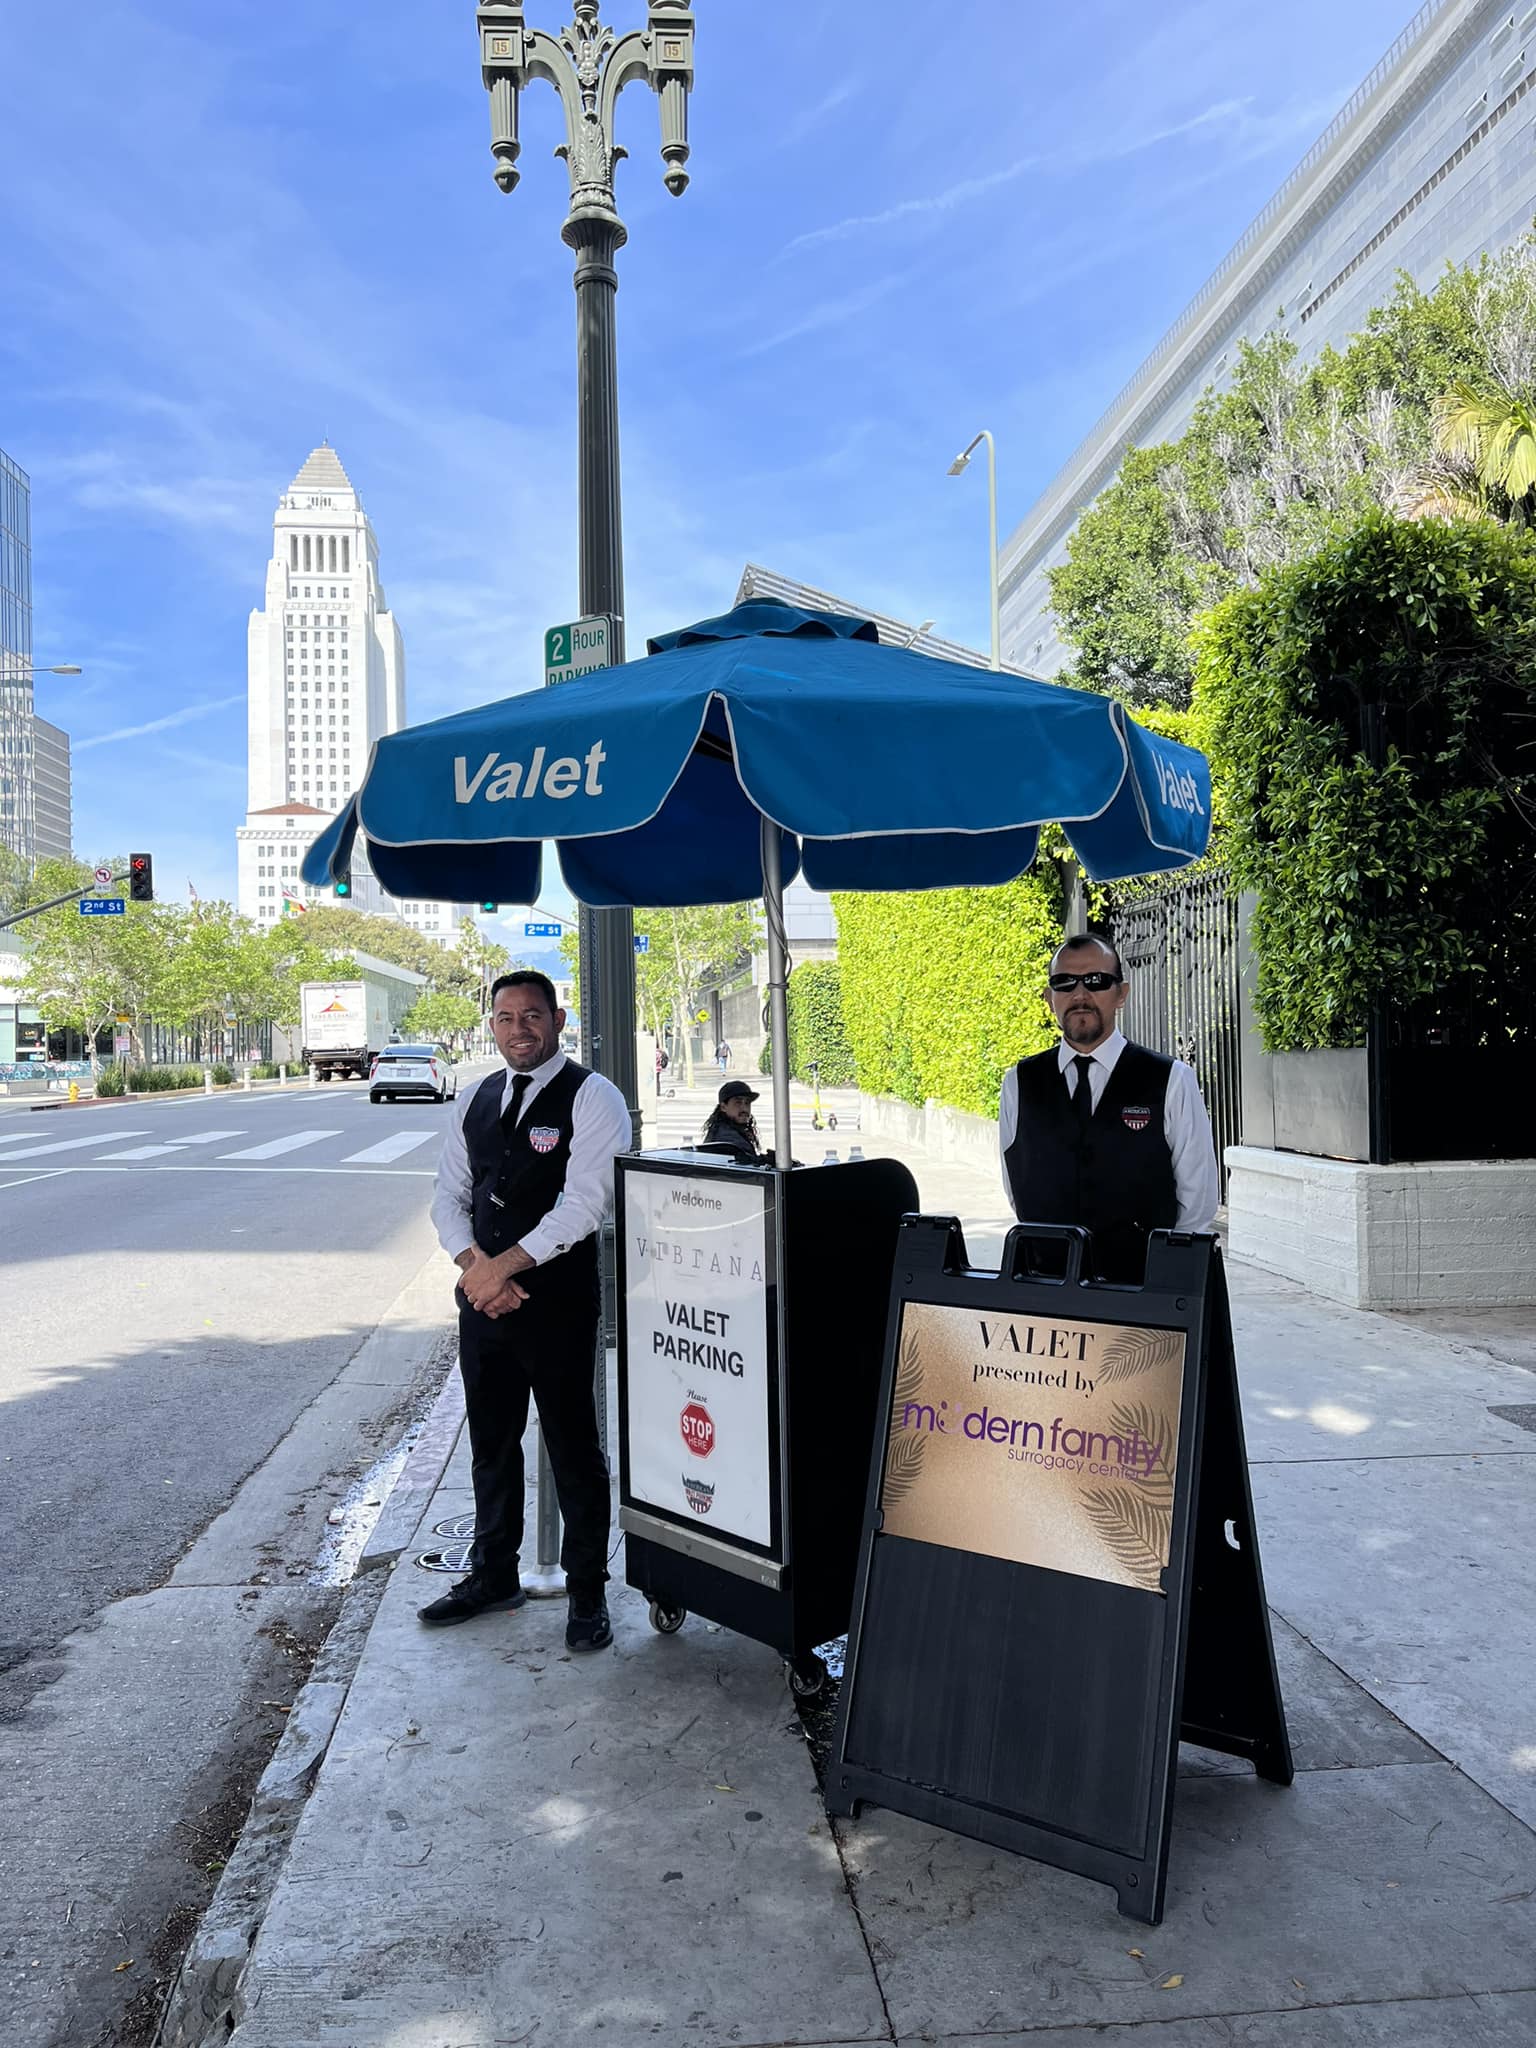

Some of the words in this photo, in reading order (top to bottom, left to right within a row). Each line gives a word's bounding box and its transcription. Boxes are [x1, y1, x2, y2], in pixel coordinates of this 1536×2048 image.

[494, 40, 507, 52] 15
[665, 44, 679, 57] 15
[552, 632, 565, 661] 2
[573, 629, 605, 651] HOUR
[454, 739, 606, 804] Valet
[1152, 750, 1205, 815] Valet
[83, 901, 104, 913] 2nd
[108, 902, 121, 911] St
[527, 925, 544, 935] 2nd
[548, 925, 559, 934] St
[671, 1190, 723, 1211] Welcome
[636, 1237, 763, 1281] VIBIANA
[665, 1300, 730, 1338] VALET
[653, 1331, 744, 1378] PARKING
[978, 1320, 1095, 1362] VALET
[973, 1363, 1068, 1389] presented
[1075, 1371, 1098, 1399] by
[682, 1414, 713, 1441] STOP
[688, 1436, 708, 1451] HERE
[1008, 1448, 1084, 1474] surrogacy
[1088, 1462, 1139, 1481] center
[1050, 1418, 1164, 1478] family
